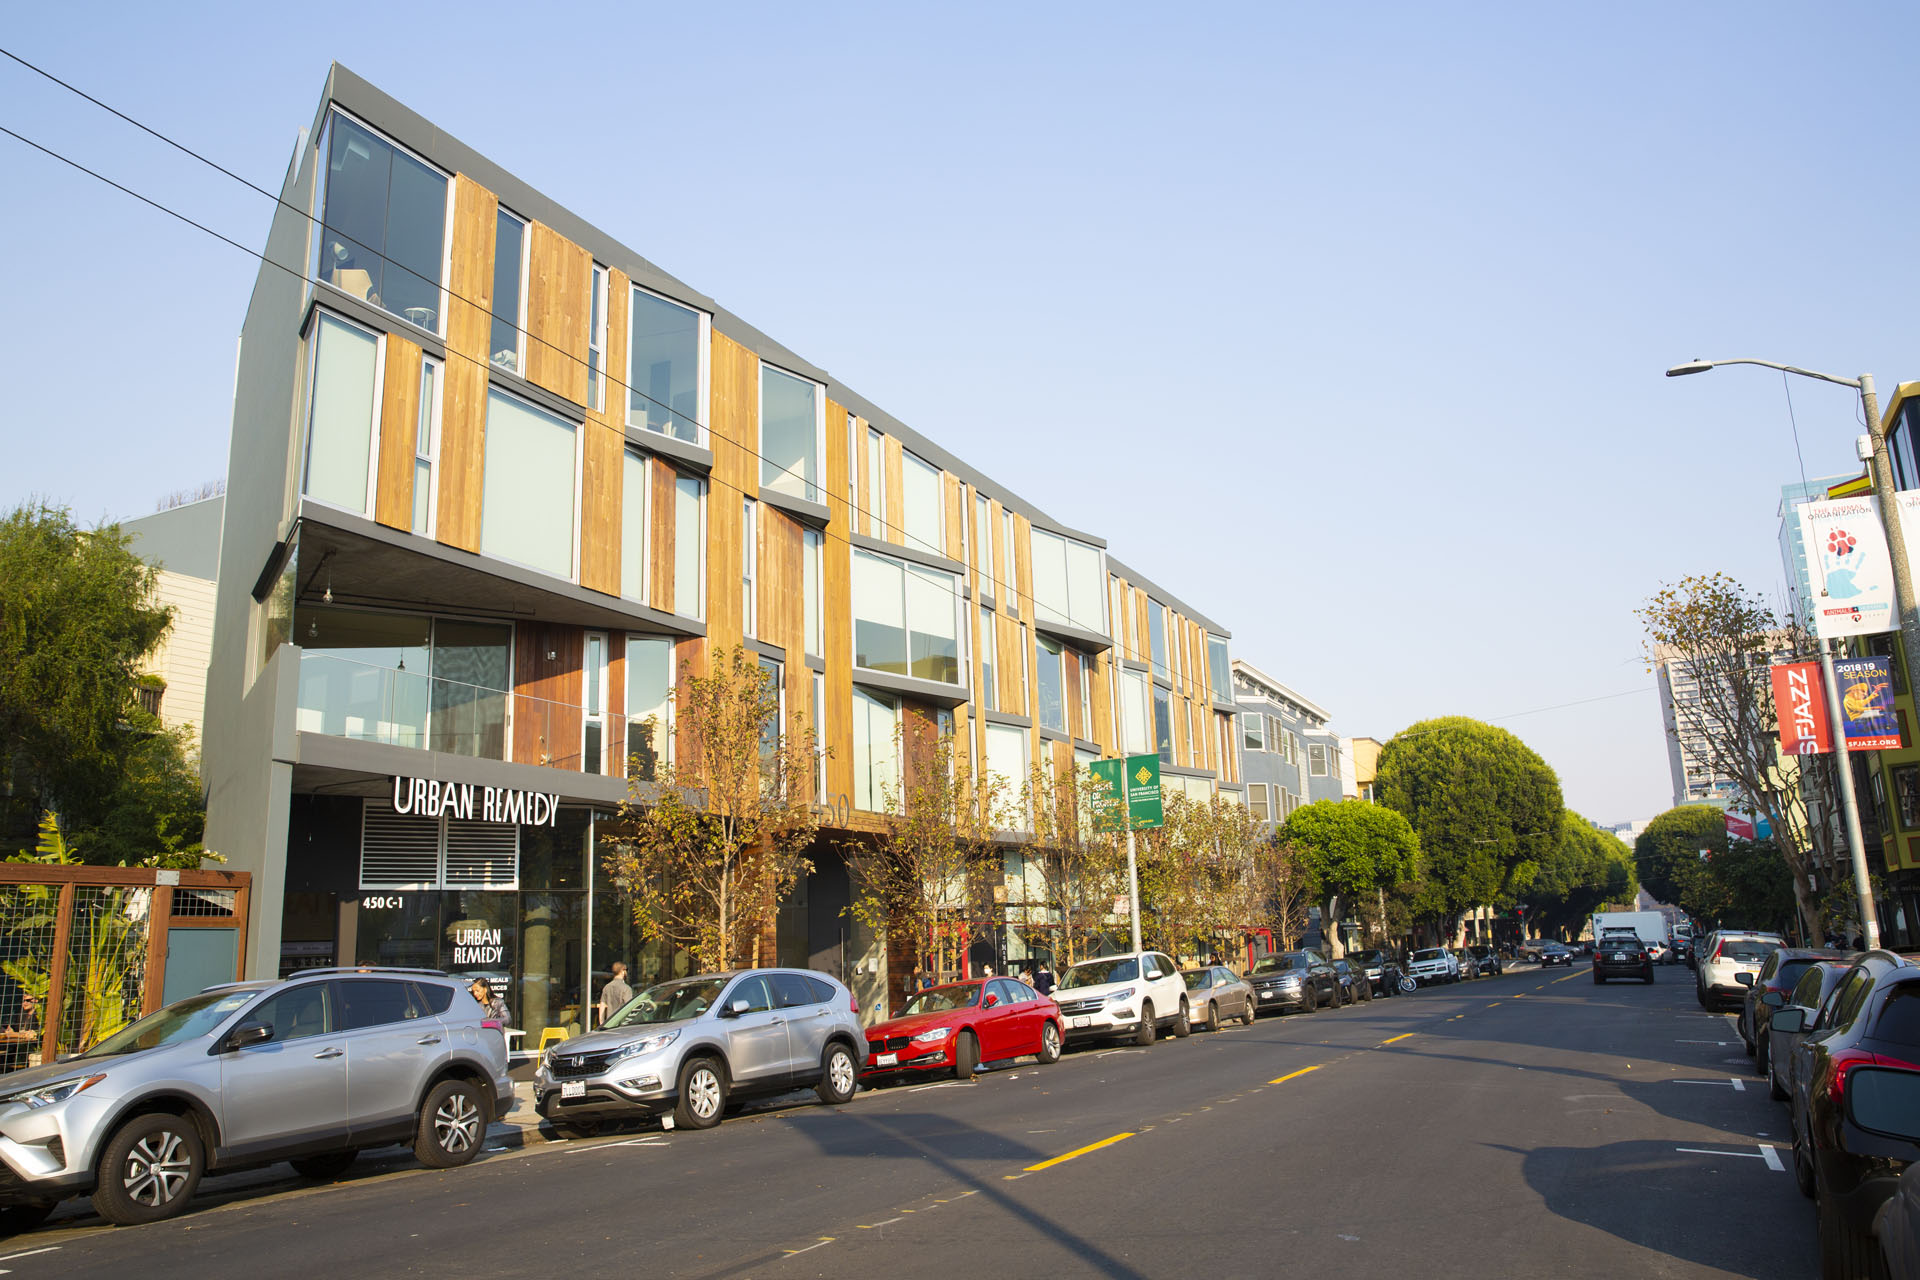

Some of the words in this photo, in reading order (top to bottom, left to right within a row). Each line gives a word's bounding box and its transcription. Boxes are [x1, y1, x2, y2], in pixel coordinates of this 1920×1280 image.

[1807, 506, 1872, 520] ORGANIZATION
[1837, 663, 1861, 673] 2018
[1843, 669, 1888, 680] SEASON
[1787, 668, 1819, 755] SFJAZZ
[1847, 739, 1897, 748] SFJAZZ.ORG
[393, 775, 475, 820] URBAN
[482, 786, 560, 828] REMEDY
[810, 790, 850, 829] 450
[362, 896, 385, 909] 450
[385, 896, 403, 909] C-1
[456, 928, 502, 946] URBAN
[453, 946, 504, 964] REMEDY
